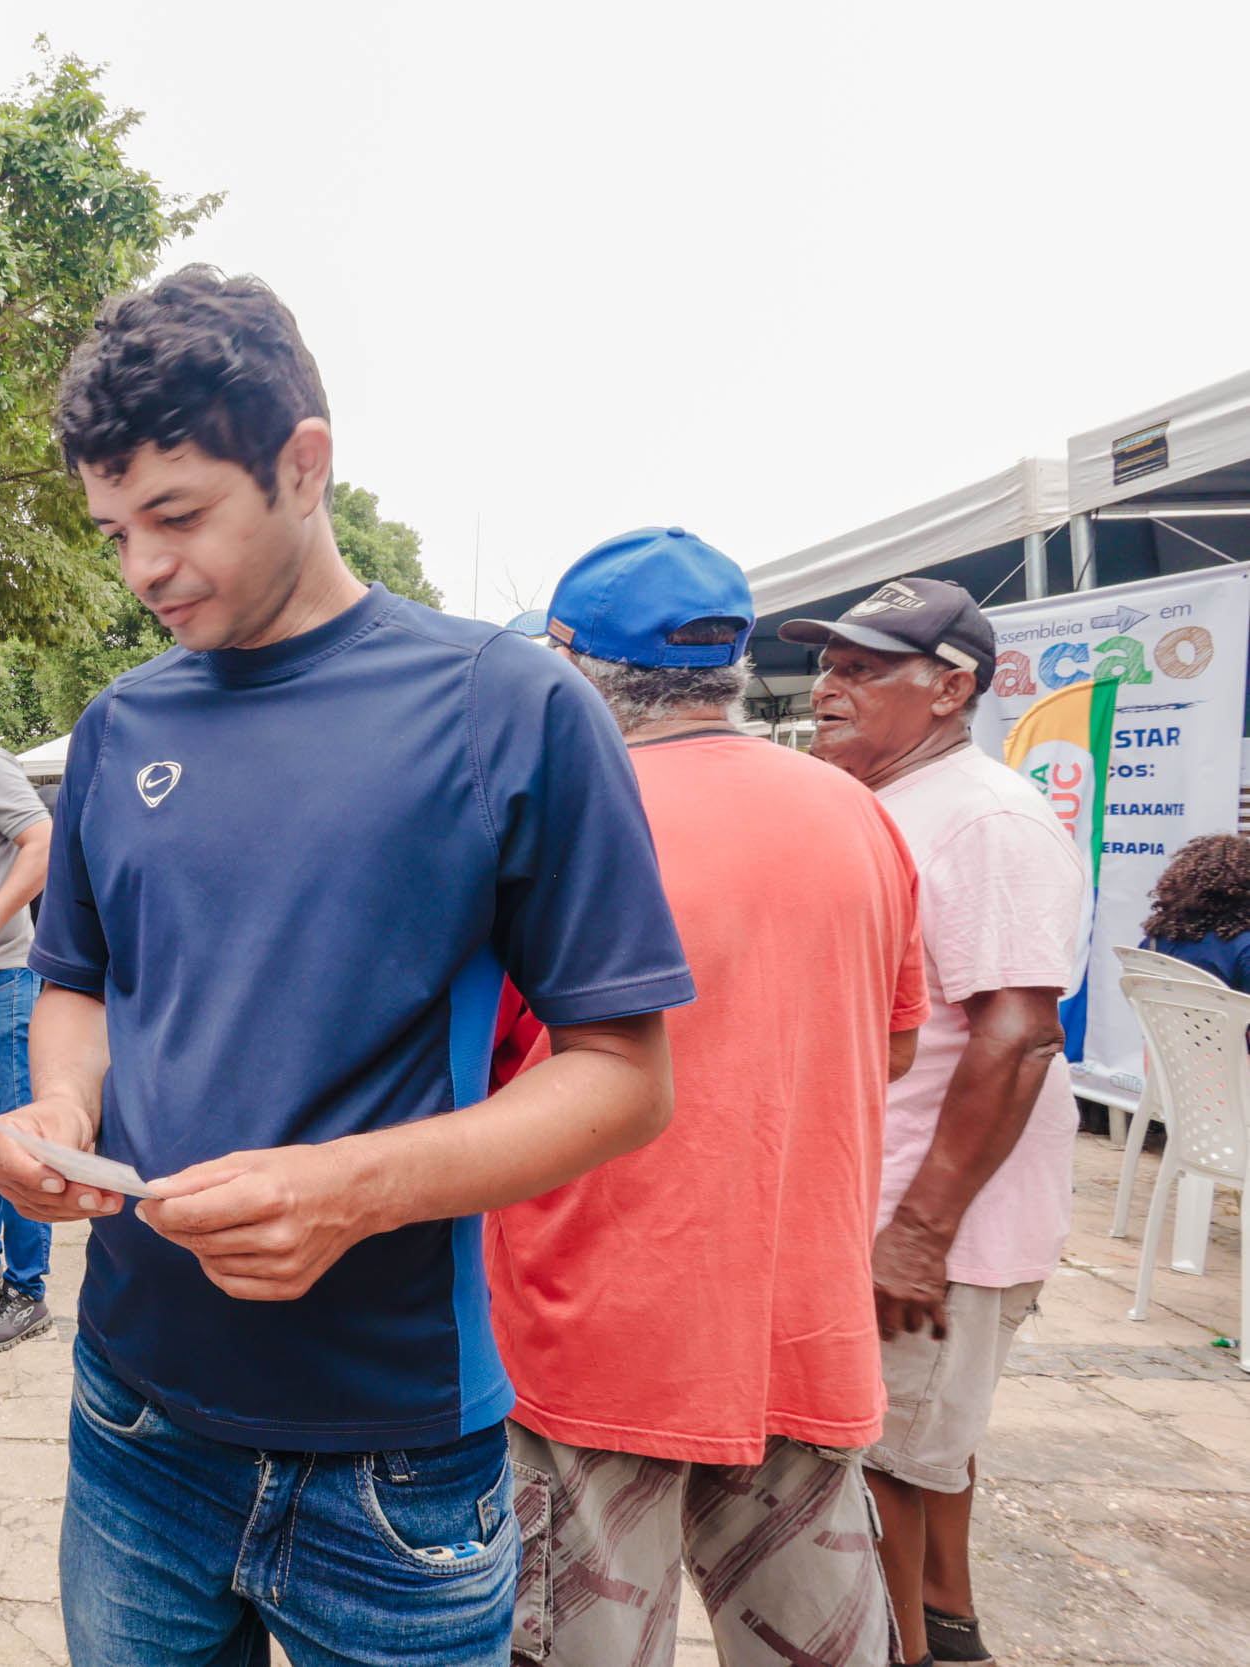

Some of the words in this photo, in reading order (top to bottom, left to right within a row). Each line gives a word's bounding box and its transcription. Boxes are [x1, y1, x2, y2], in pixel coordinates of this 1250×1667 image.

[1159, 603, 1192, 620] em
[1111, 727, 1181, 749] STAR
[1102, 842, 1165, 855] ERAPIA
